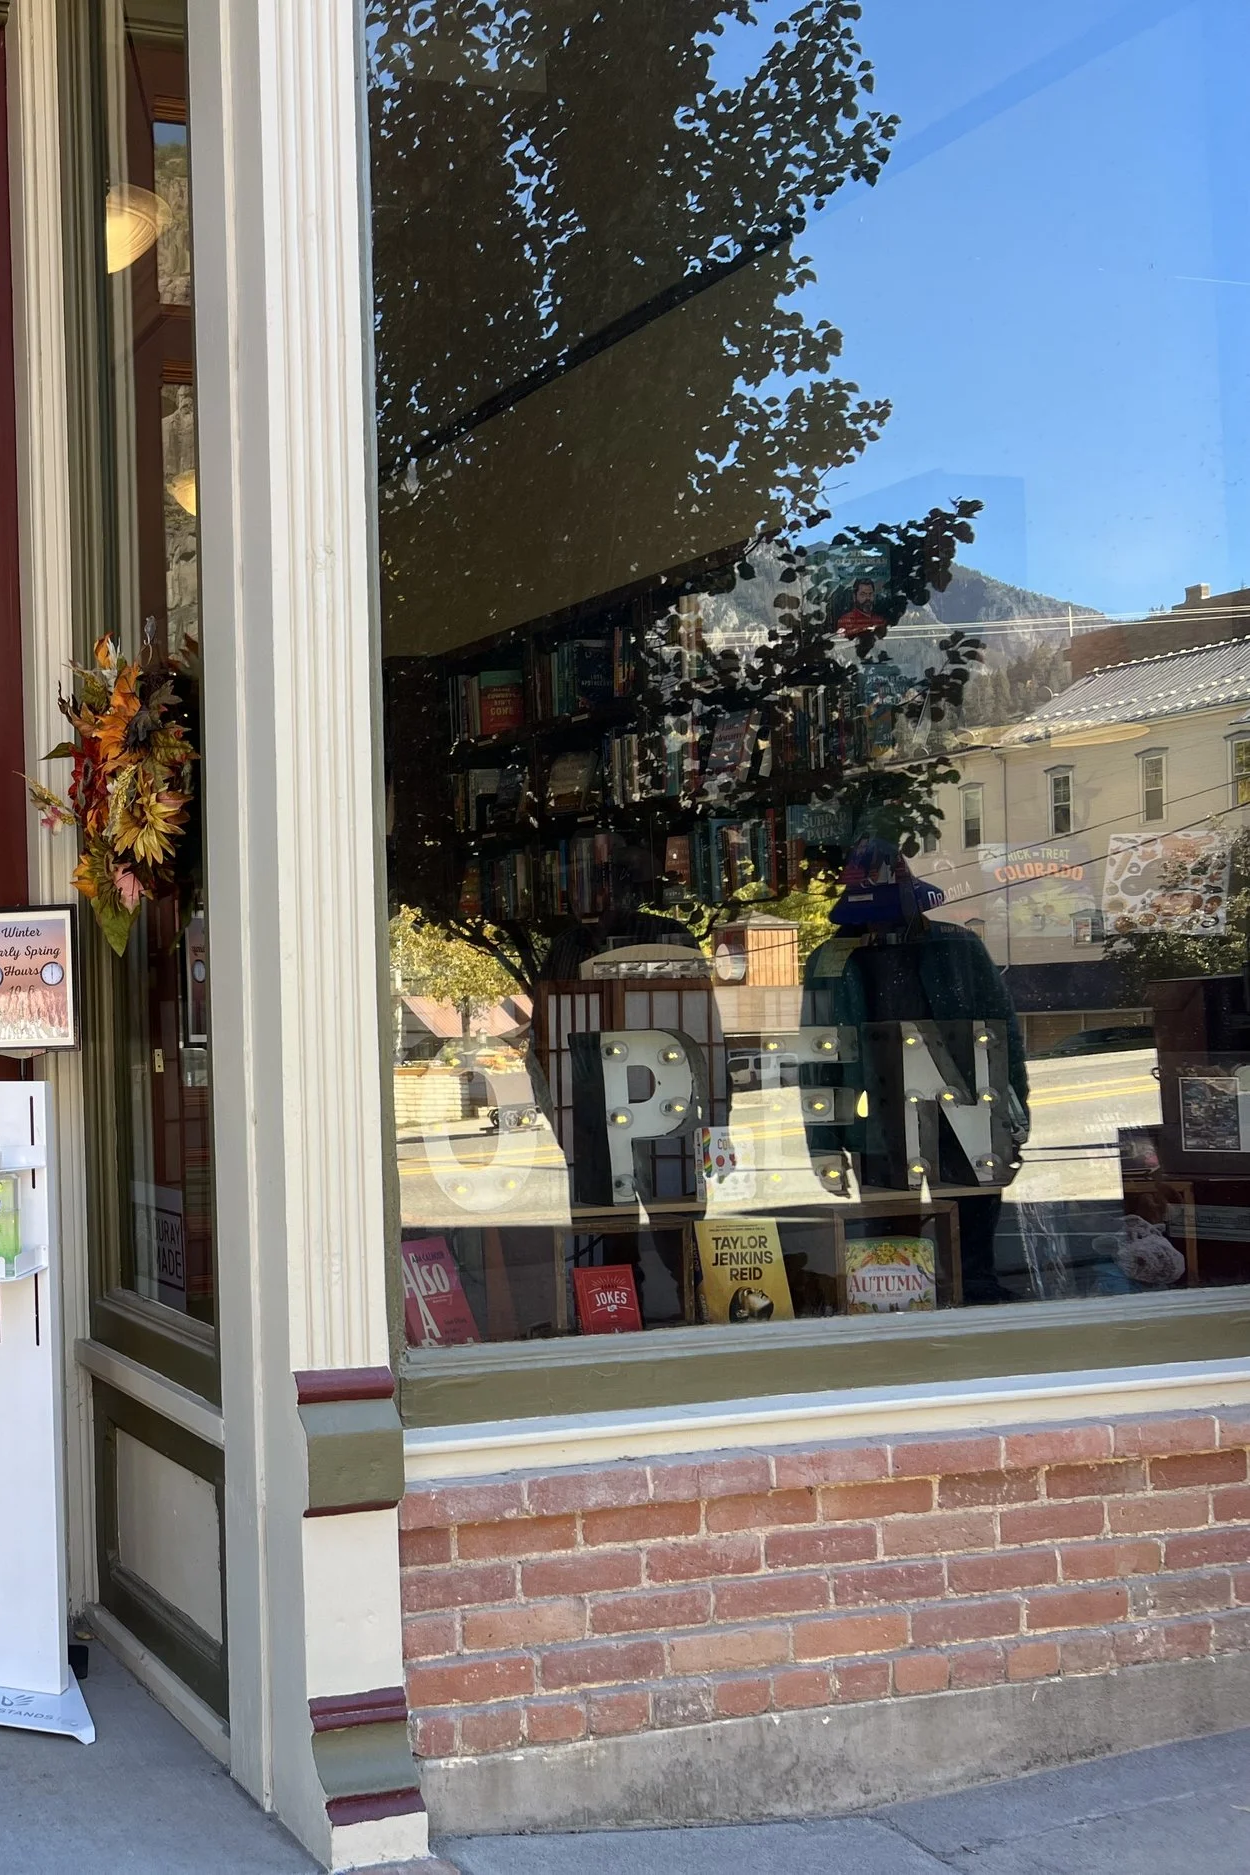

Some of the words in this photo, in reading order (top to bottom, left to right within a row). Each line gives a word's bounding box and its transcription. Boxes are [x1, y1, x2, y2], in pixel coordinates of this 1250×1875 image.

[994, 861, 1084, 883] COLORADO
[927, 880, 973, 908] DRACULA
[1, 926, 42, 938] Winter
[24, 945, 62, 960] Spring
[3, 966, 40, 977] Hours
[711, 1235, 768, 1250] TAYLOR
[712, 1251, 774, 1267] JENKINS
[729, 1267, 763, 1281] REID
[849, 1275, 923, 1293] AUTUMN
[595, 1291, 627, 1306] JOKES
